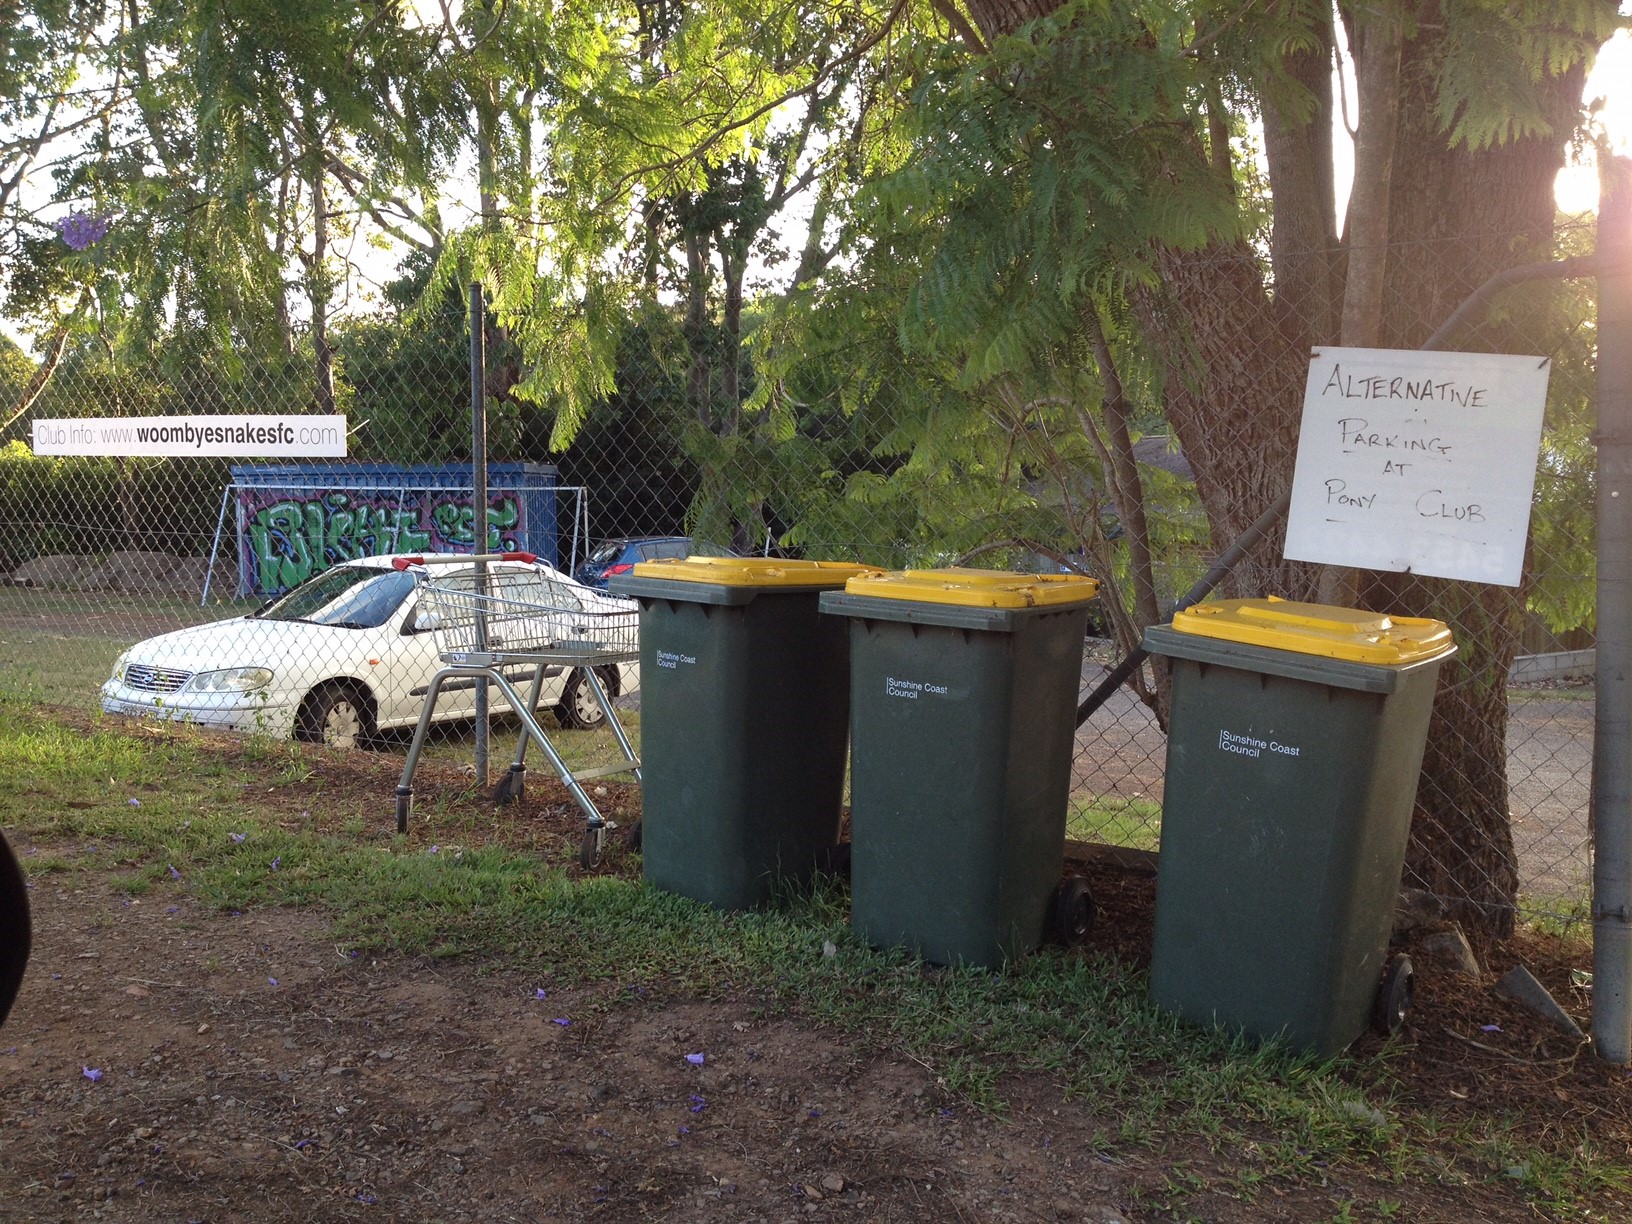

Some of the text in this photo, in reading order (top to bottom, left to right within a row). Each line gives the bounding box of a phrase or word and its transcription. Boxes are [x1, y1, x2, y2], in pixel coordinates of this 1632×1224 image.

[1322, 363, 1488, 408] ALTERNATIVE
[37, 422, 339, 448] Club Info: www.woombyesnakesfc.com
[1338, 417, 1453, 455] PARKING
[1382, 460, 1414, 477] AT
[1324, 478, 1486, 523] PONY CLUB
[658, 650, 696, 664] Sunshine Coast
[658, 658, 677, 669] Council
[888, 677, 948, 694] Sunshine Coast
[888, 686, 918, 699] Council
[1221, 741, 1260, 758] Council
[1222, 730, 1300, 756] Sunshine Coast
